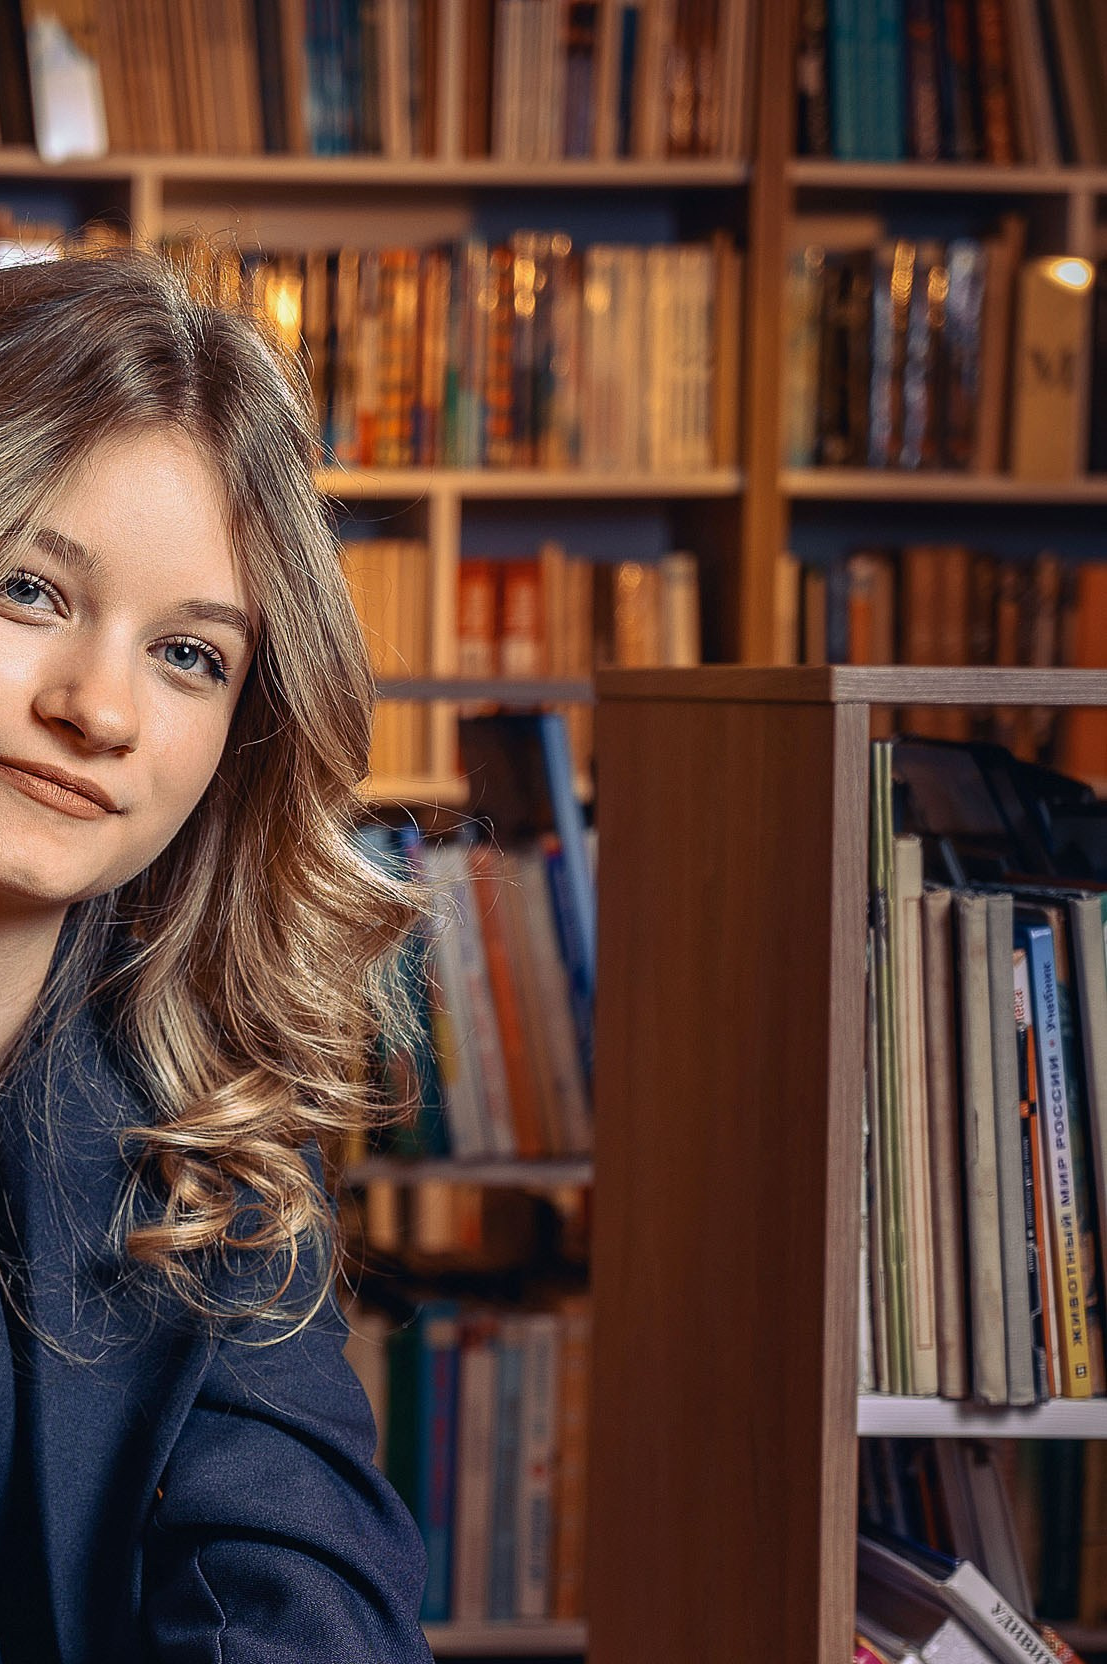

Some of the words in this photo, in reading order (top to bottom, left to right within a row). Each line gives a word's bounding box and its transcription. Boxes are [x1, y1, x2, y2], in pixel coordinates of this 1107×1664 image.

[1049, 1055, 1066, 1151] РОССИИ
[1057, 1156, 1071, 1208] МИР
[1061, 1213, 1083, 1347] ЖИВОТНЫЙ
